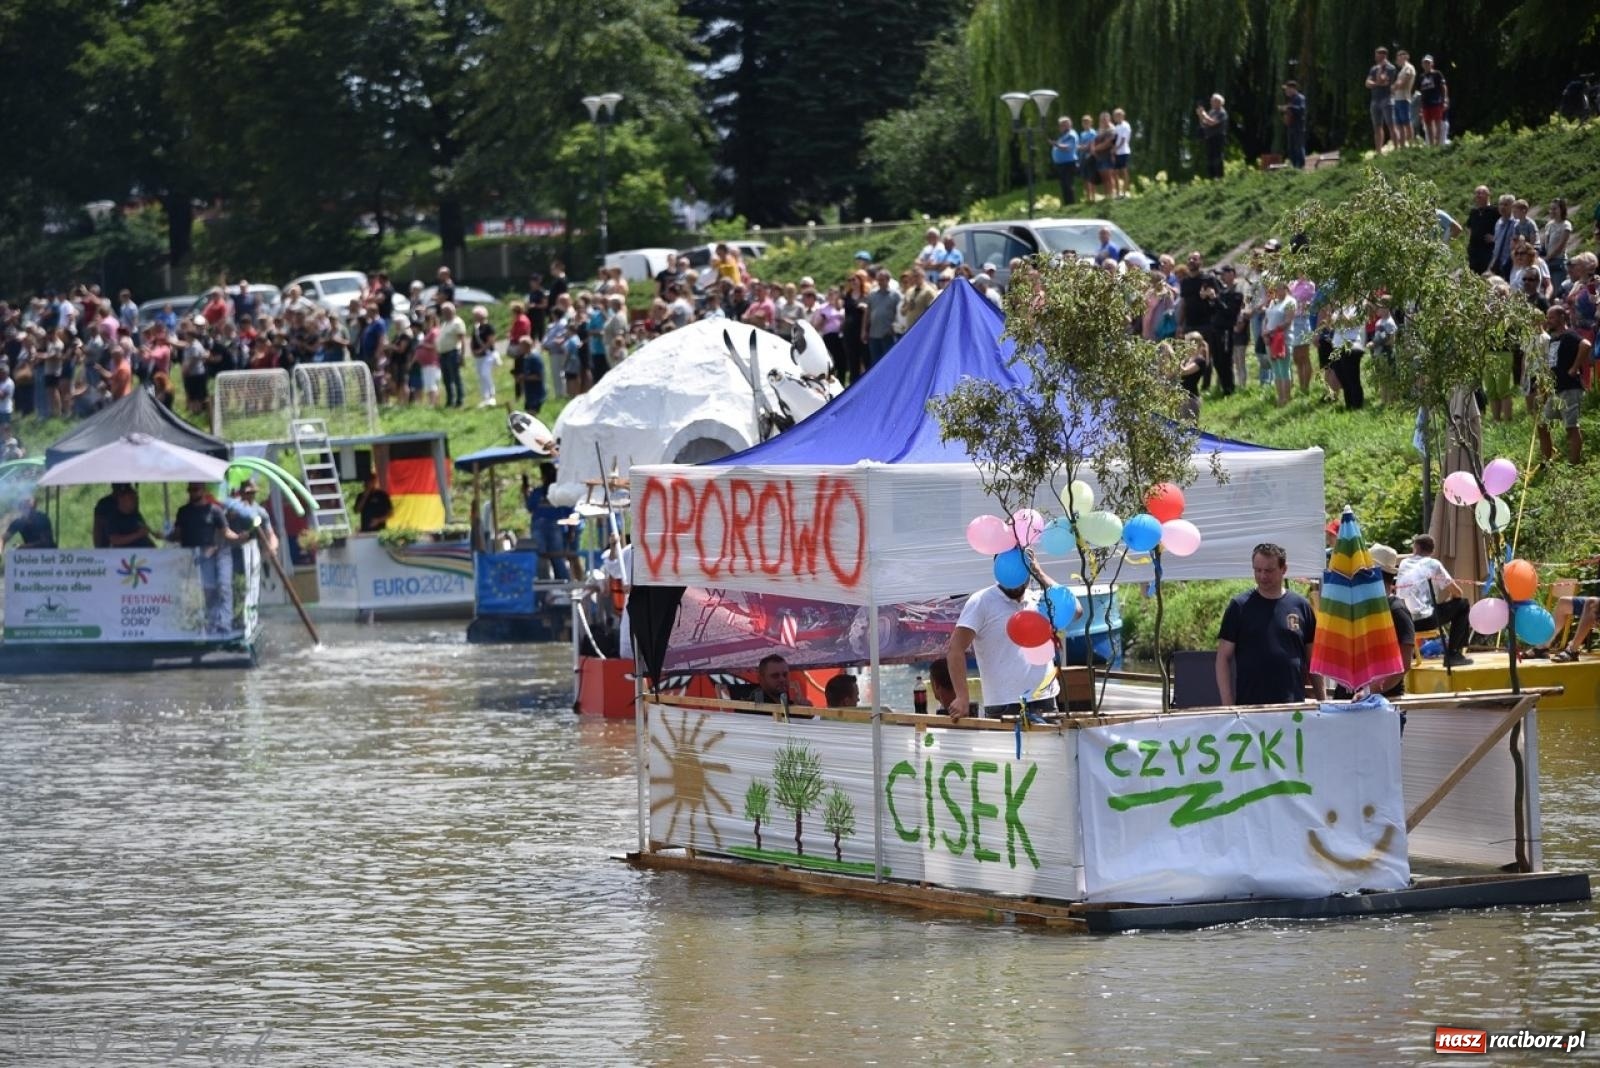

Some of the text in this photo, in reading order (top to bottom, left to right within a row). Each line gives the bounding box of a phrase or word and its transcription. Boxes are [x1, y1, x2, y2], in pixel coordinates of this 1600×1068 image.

[639, 473, 866, 588] OPOROWO
[59, 553, 74, 564] 20
[372, 574, 464, 597] EURO2024
[121, 594, 174, 605] FESTIWAL
[121, 617, 152, 627] ODRY
